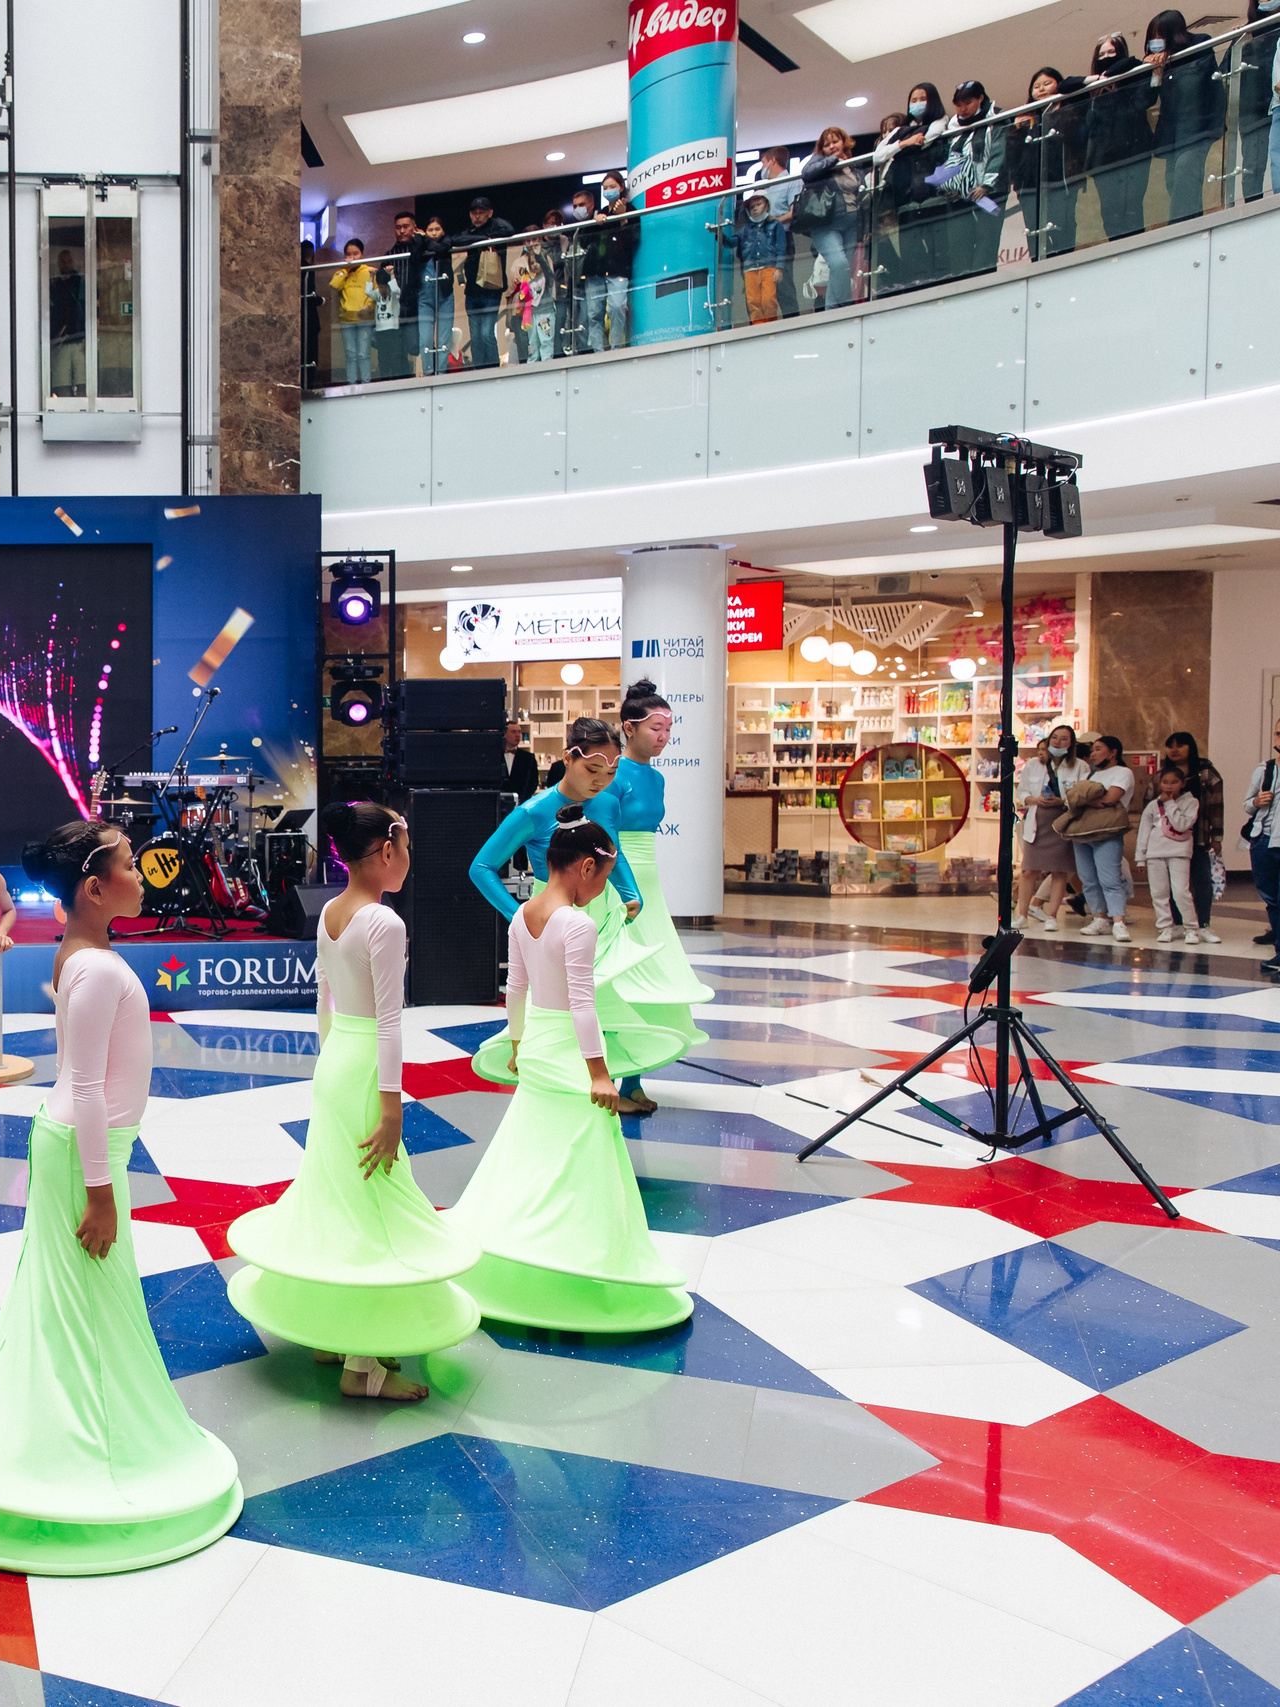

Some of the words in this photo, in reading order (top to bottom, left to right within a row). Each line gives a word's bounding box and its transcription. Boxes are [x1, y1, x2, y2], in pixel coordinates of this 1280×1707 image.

[631, 148, 719, 189] ОТКРЫЛИСЬ!
[661, 185, 673, 200] 3
[675, 174, 724, 197] ЭТАЖ
[663, 635, 704, 647] ЧИТАЙ
[663, 648, 705, 658] ГОРОД
[664, 694, 705, 703] ЛЛЕРЫ
[197, 957, 319, 986] FORUM
[198, 987, 300, 997] торгово-развлекательный
